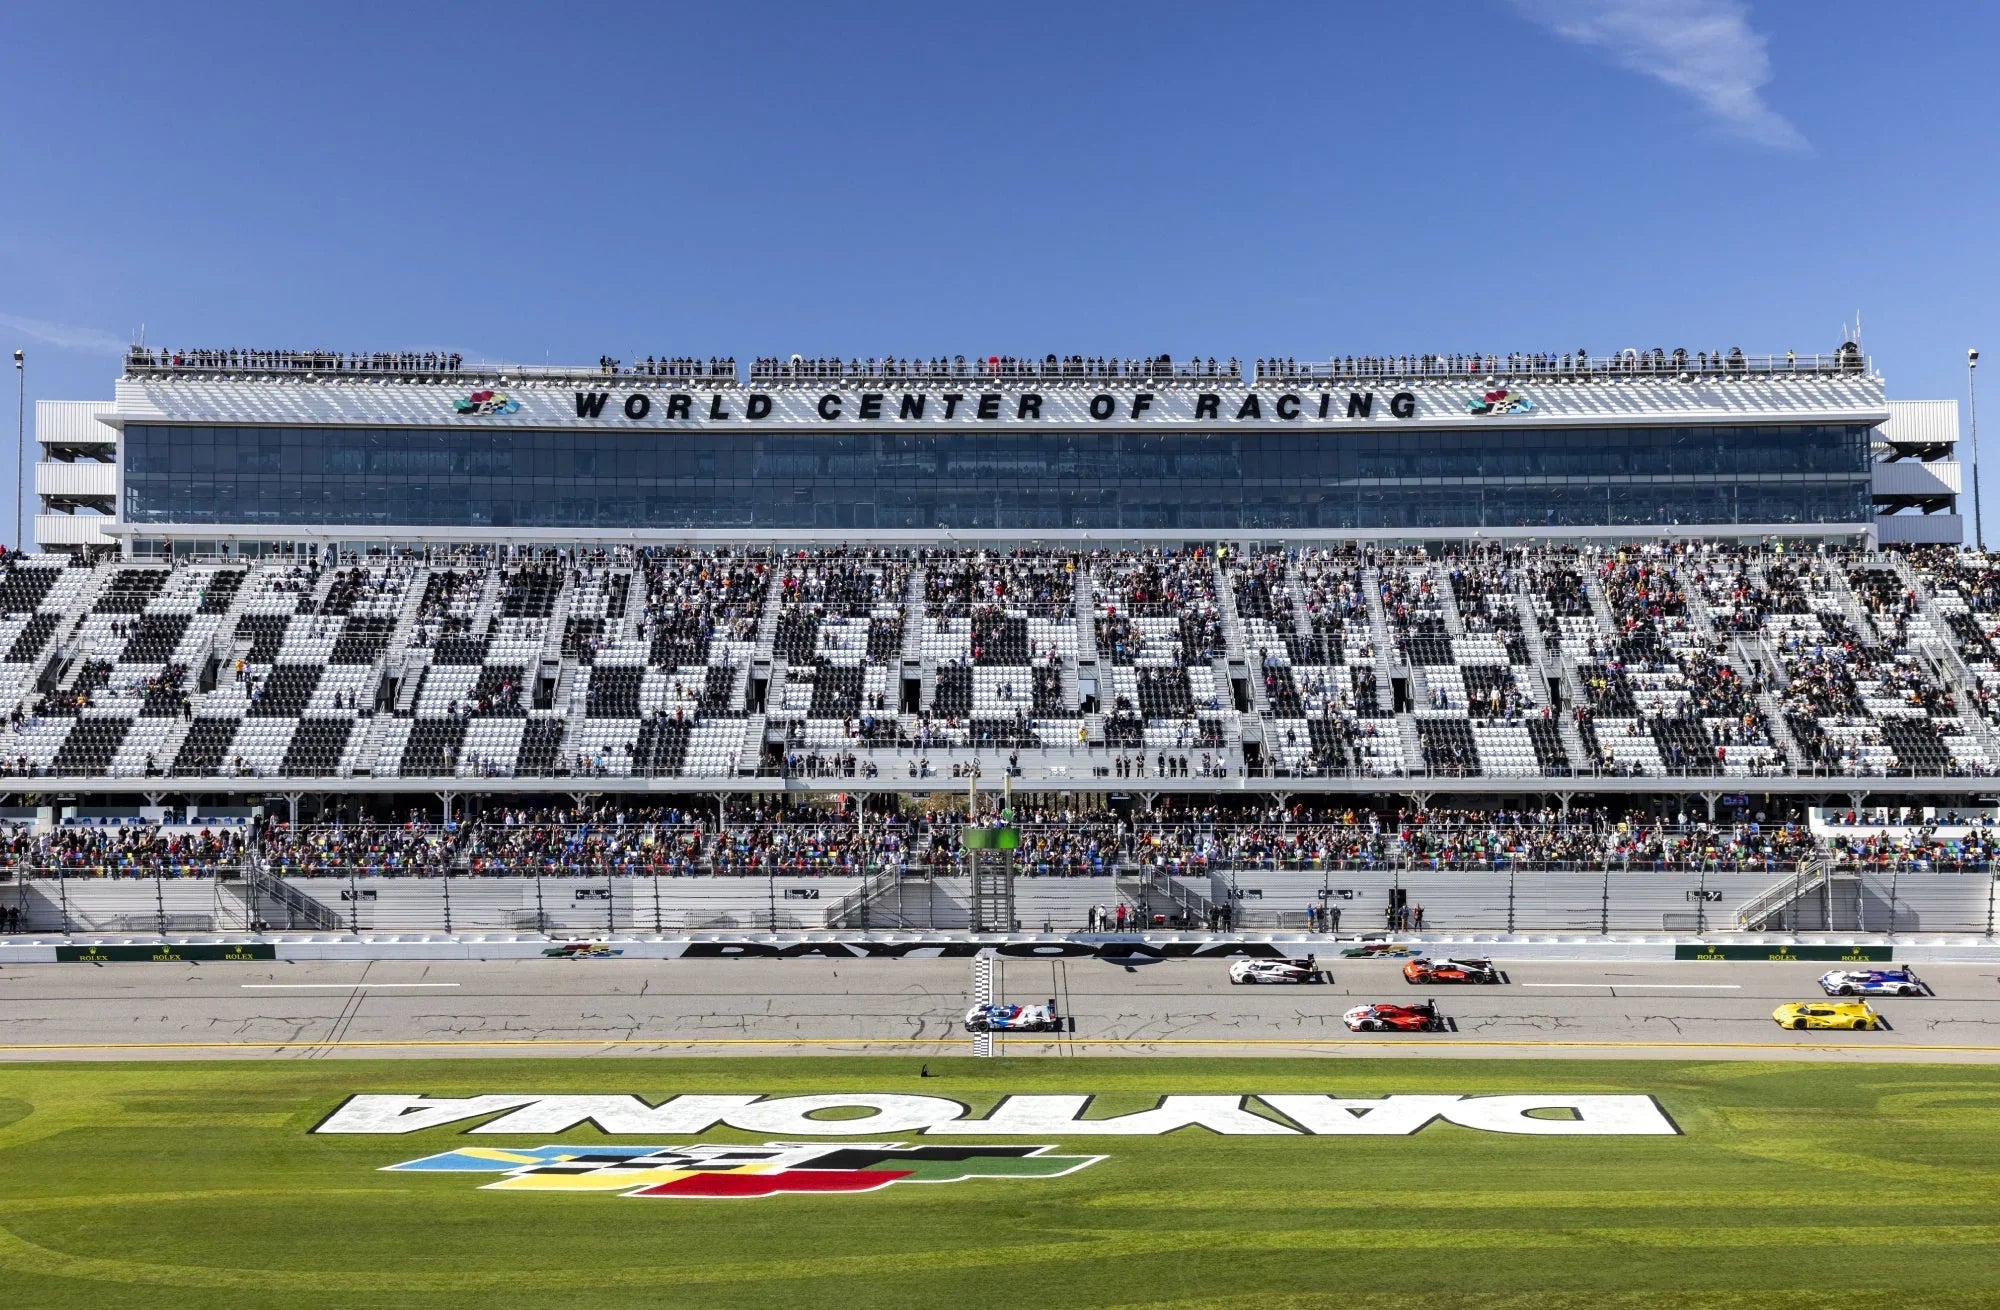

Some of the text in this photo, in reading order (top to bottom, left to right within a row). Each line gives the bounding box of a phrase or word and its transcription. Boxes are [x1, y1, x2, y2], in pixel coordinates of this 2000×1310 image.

[575, 392, 1416, 420] WORLD CENTER OF RACING
[679, 942, 1287, 958] DAYTONA
[307, 1093, 1685, 1136] DAYTONA
